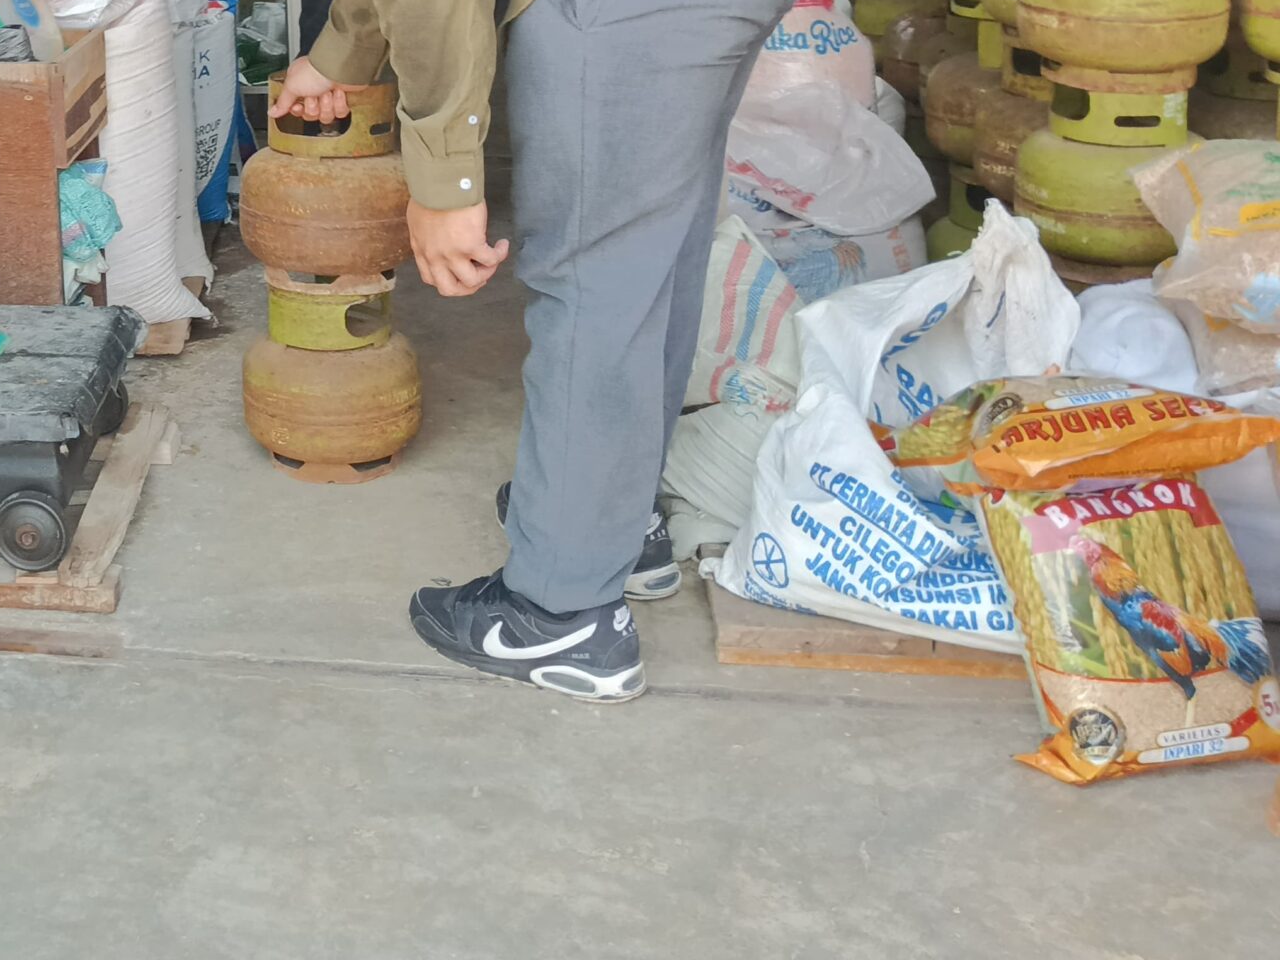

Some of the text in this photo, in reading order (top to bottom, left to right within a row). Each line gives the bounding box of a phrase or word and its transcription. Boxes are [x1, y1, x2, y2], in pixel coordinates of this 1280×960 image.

[810, 20, 858, 55] Rice
[1001, 404, 1135, 448] ARJUNA
[829, 470, 917, 548] PERMATA
[1043, 481, 1197, 529] BANGKOK
[790, 504, 864, 575] UNTUK
[858, 564, 982, 606] KONSUMSI
[839, 515, 916, 585] CILEGO
[899, 608, 979, 631] PAKAI
[1163, 743, 1206, 761] INPARI
